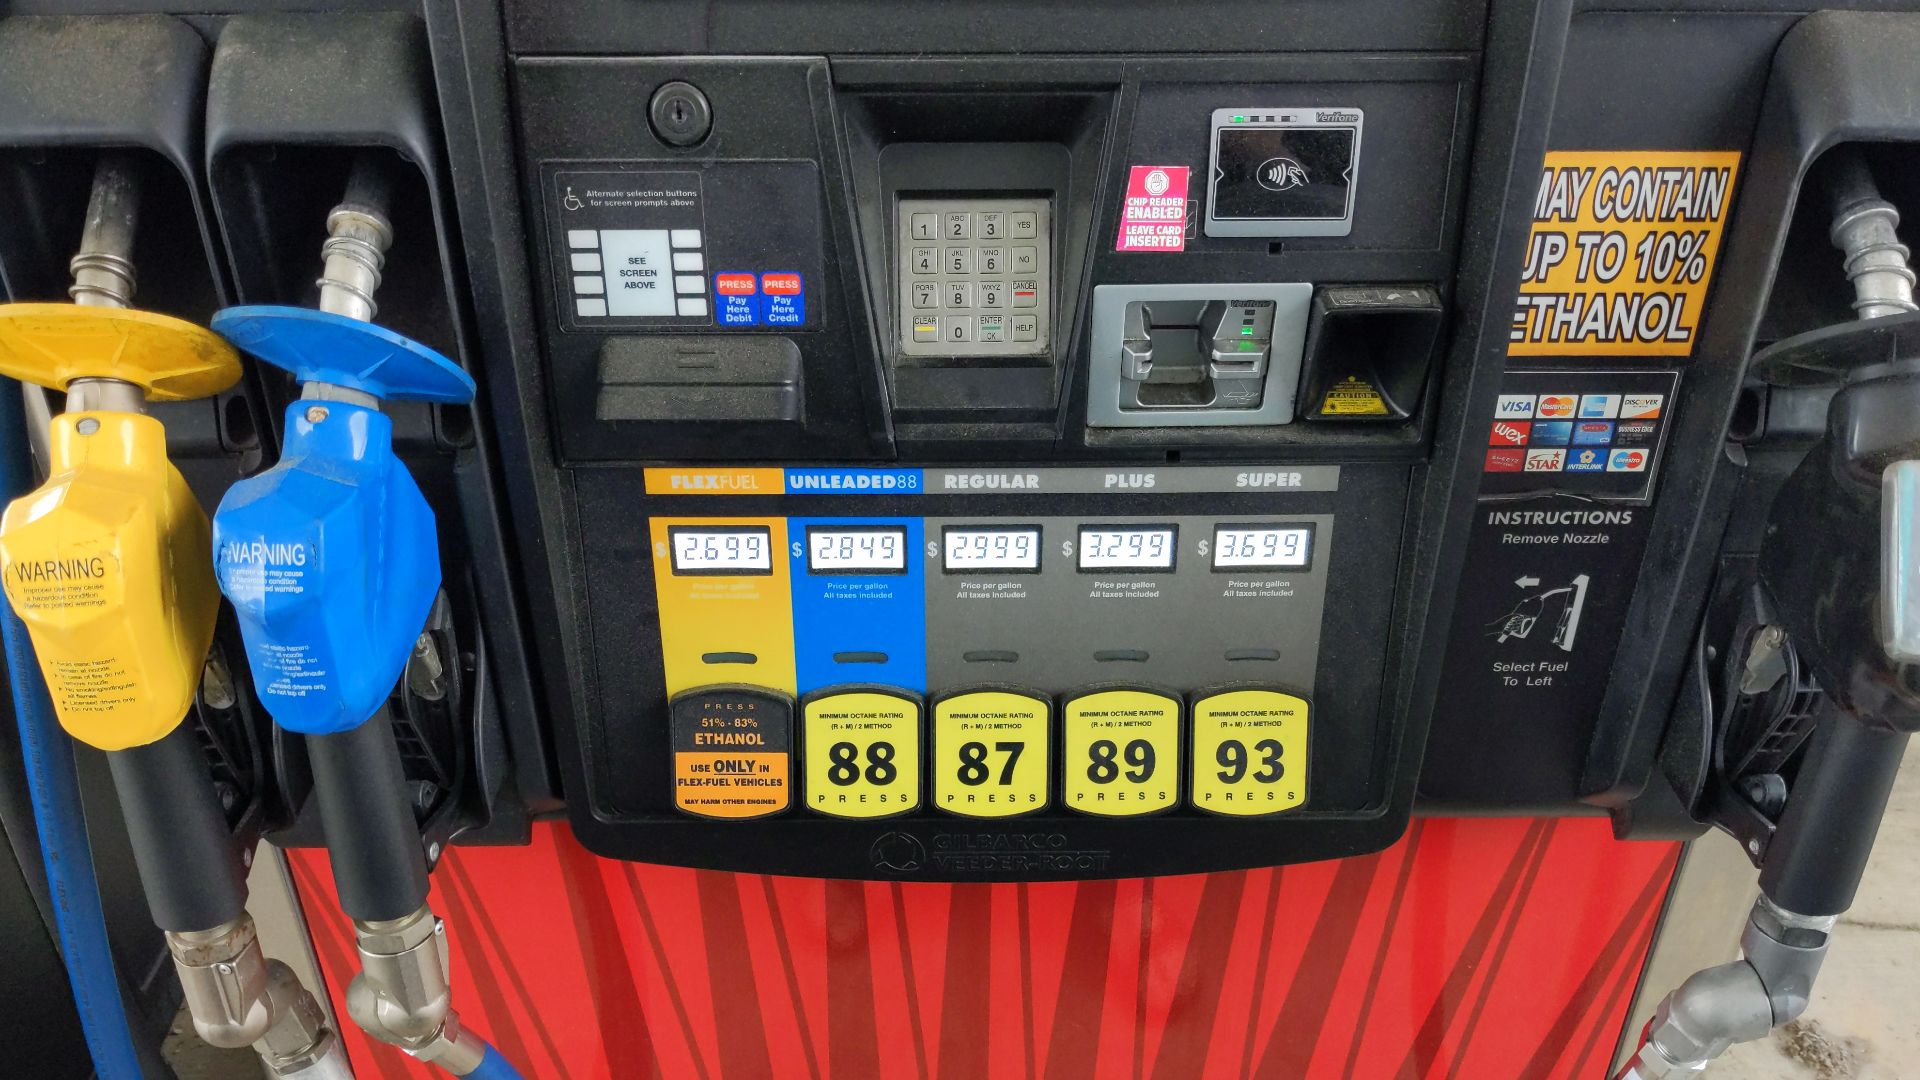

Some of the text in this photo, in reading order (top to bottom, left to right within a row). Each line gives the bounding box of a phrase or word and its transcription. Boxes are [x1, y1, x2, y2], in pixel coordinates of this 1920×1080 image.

[1316, 112, 1359, 122] Verifone
[1593, 166, 1730, 222] CONTAIN
[1127, 207, 1182, 219] ENABLED
[921, 224, 927, 235] 1
[954, 224, 962, 235] 2
[987, 224, 994, 235] 3
[1126, 226, 1181, 234] LEAVE CARD
[1125, 236, 1180, 247] INSERTED
[1575, 231, 1627, 283] TO
[1635, 231, 1710, 284] 10%
[921, 259, 928, 269] 4
[954, 259, 962, 270] 5
[987, 258, 995, 270] 6
[729, 296, 746, 305] Pay
[774, 296, 791, 305] Pay
[921, 294, 929, 304] 7
[954, 293, 962, 304] 8
[987, 293, 995, 304] 9
[1510, 292, 1692, 343] ETHANOL
[955, 327, 962, 338] 0
[1502, 402, 1531, 411] VISA
[1527, 460, 1559, 469] STAR
[671, 474, 759, 489] FLEXFUEL
[944, 474, 1040, 489] REGULAR
[1105, 474, 1155, 488] PLUS
[1236, 473, 1302, 488] SUPER
[1488, 511, 1632, 525] INSTRUCTIONS
[1502, 533, 1609, 544] Remove Nozzle
[684, 536, 760, 561] 2.699
[792, 536, 895, 560] $ 2.849
[928, 536, 1029, 559] $ 2.999
[1062, 535, 1163, 558] $ 3.299
[1198, 534, 1298, 558] $ 3.699
[228, 541, 305, 567] WARNING
[14, 557, 104, 582] WARNING
[998, 582, 1022, 590] gallon
[1131, 581, 1155, 590] gallon
[1492, 662, 1568, 672] Select Fuel
[1503, 676, 1552, 686] To Left
[701, 718, 724, 728] 51%
[735, 718, 758, 728] 83%
[695, 733, 765, 745] ETHANOL
[691, 760, 770, 773] USE ONLY IN
[828, 741, 897, 786] 88
[957, 742, 1024, 786] 87
[1087, 739, 1155, 784] 89
[1216, 739, 1284, 784] 93
[678, 778, 782, 786] FLEX-FUEL VEHICLES
[933, 833, 1067, 849] GILBARCO
[932, 855, 1110, 871] VEEDER-ROOT
